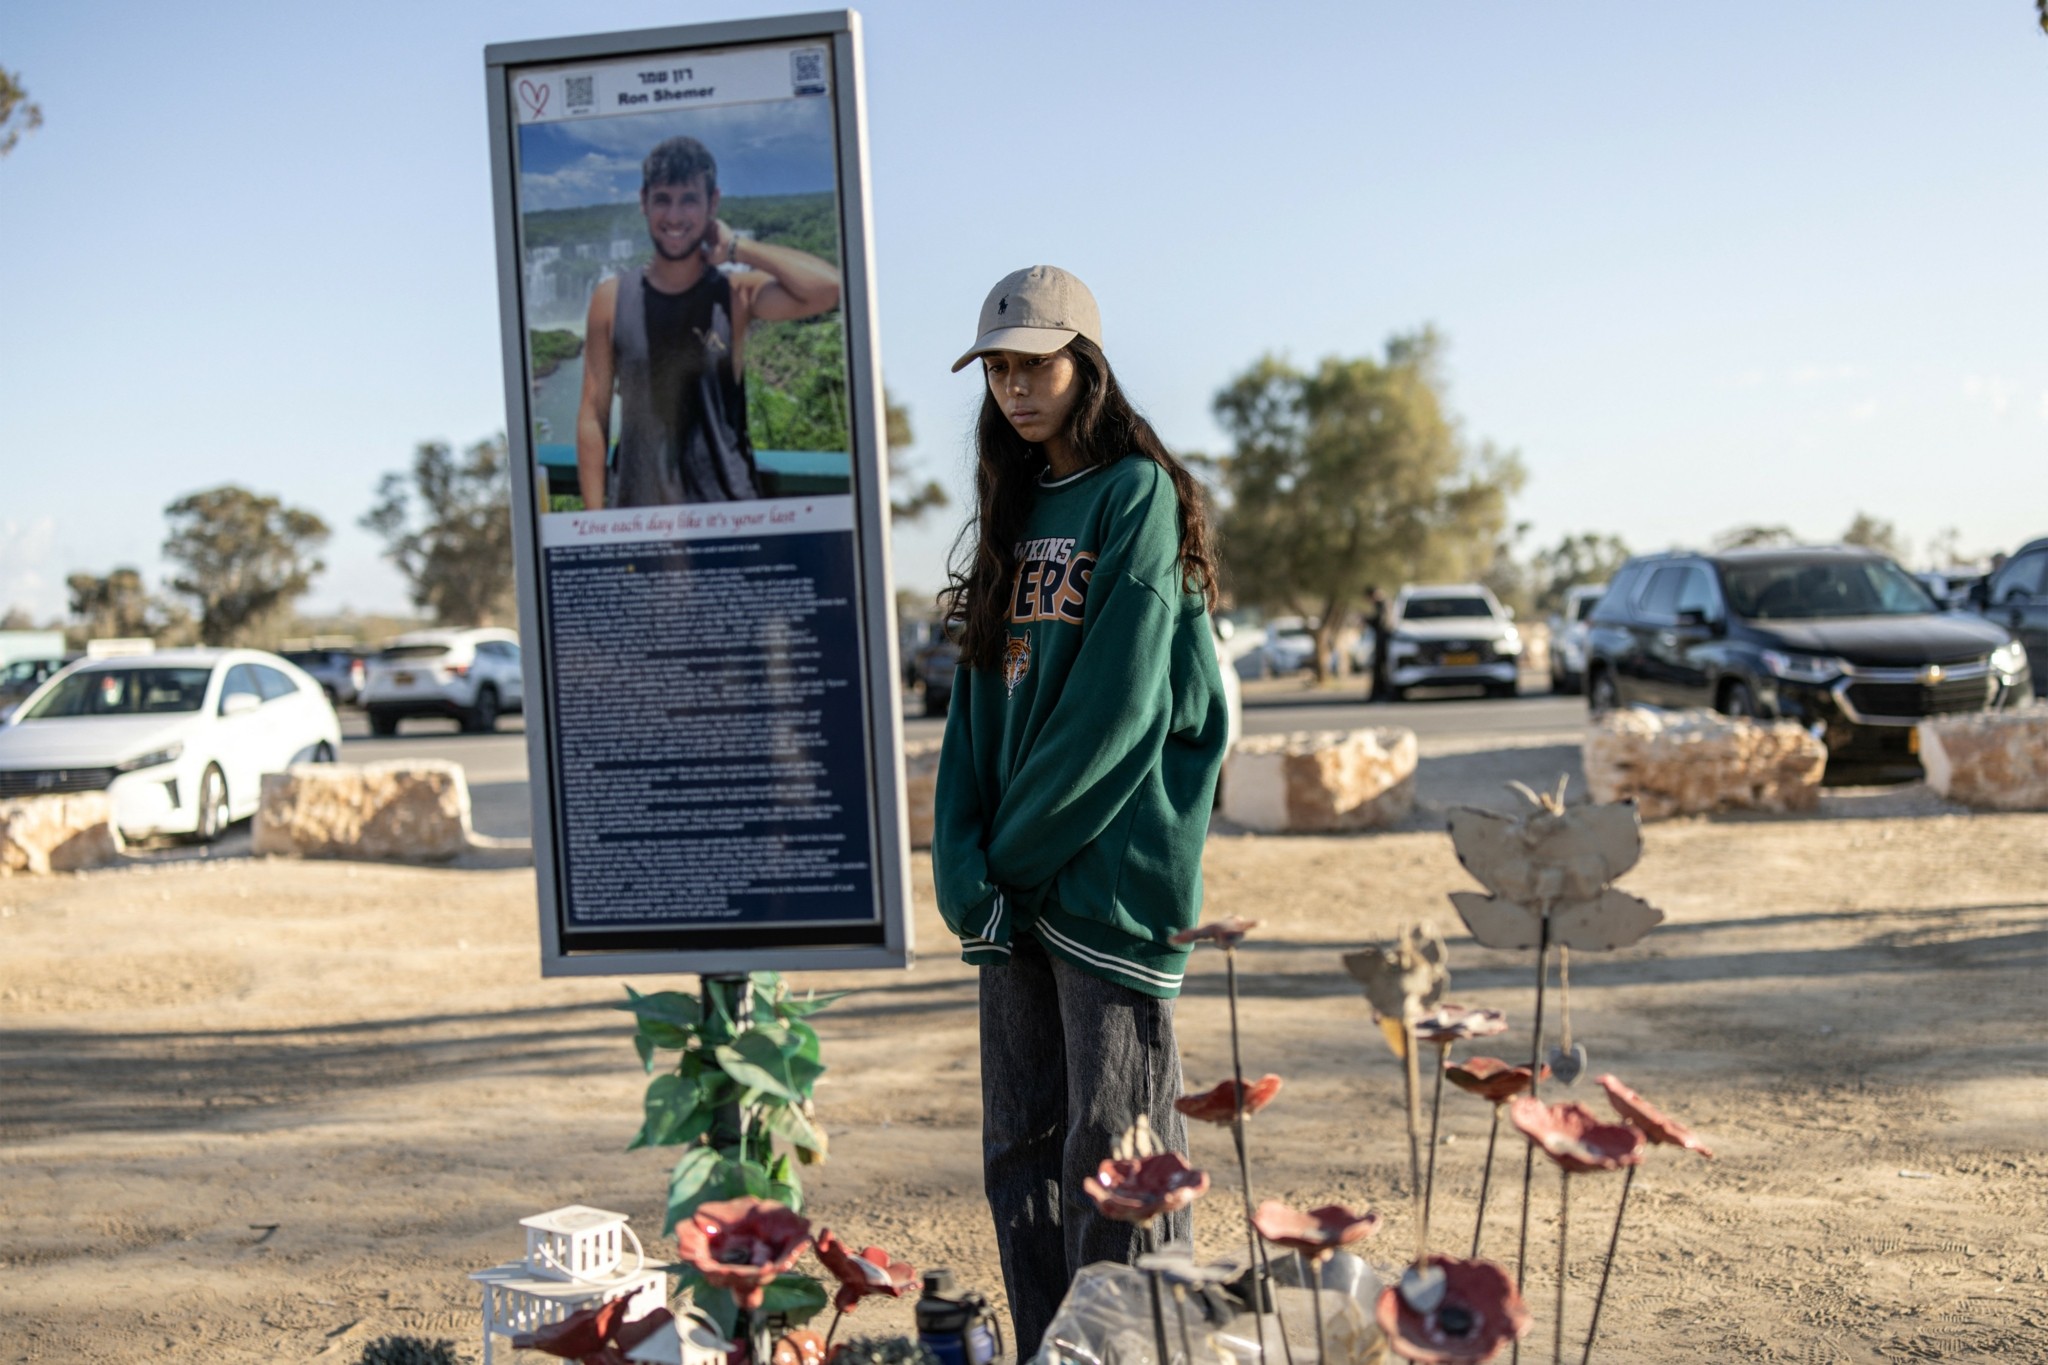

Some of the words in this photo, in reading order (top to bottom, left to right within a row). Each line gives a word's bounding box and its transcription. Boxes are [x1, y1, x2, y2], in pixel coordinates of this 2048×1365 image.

[638, 70, 669, 85] שמר
[672, 67, 694, 84] רון
[617, 92, 649, 106] Ron
[653, 86, 716, 103] Shemer
[611, 513, 643, 534] each
[646, 511, 674, 538] day
[677, 509, 702, 529] like
[731, 513, 765, 534] your
[769, 504, 796, 525] last
[1013, 537, 1076, 565] WKINS
[1006, 551, 1099, 625] ERS
